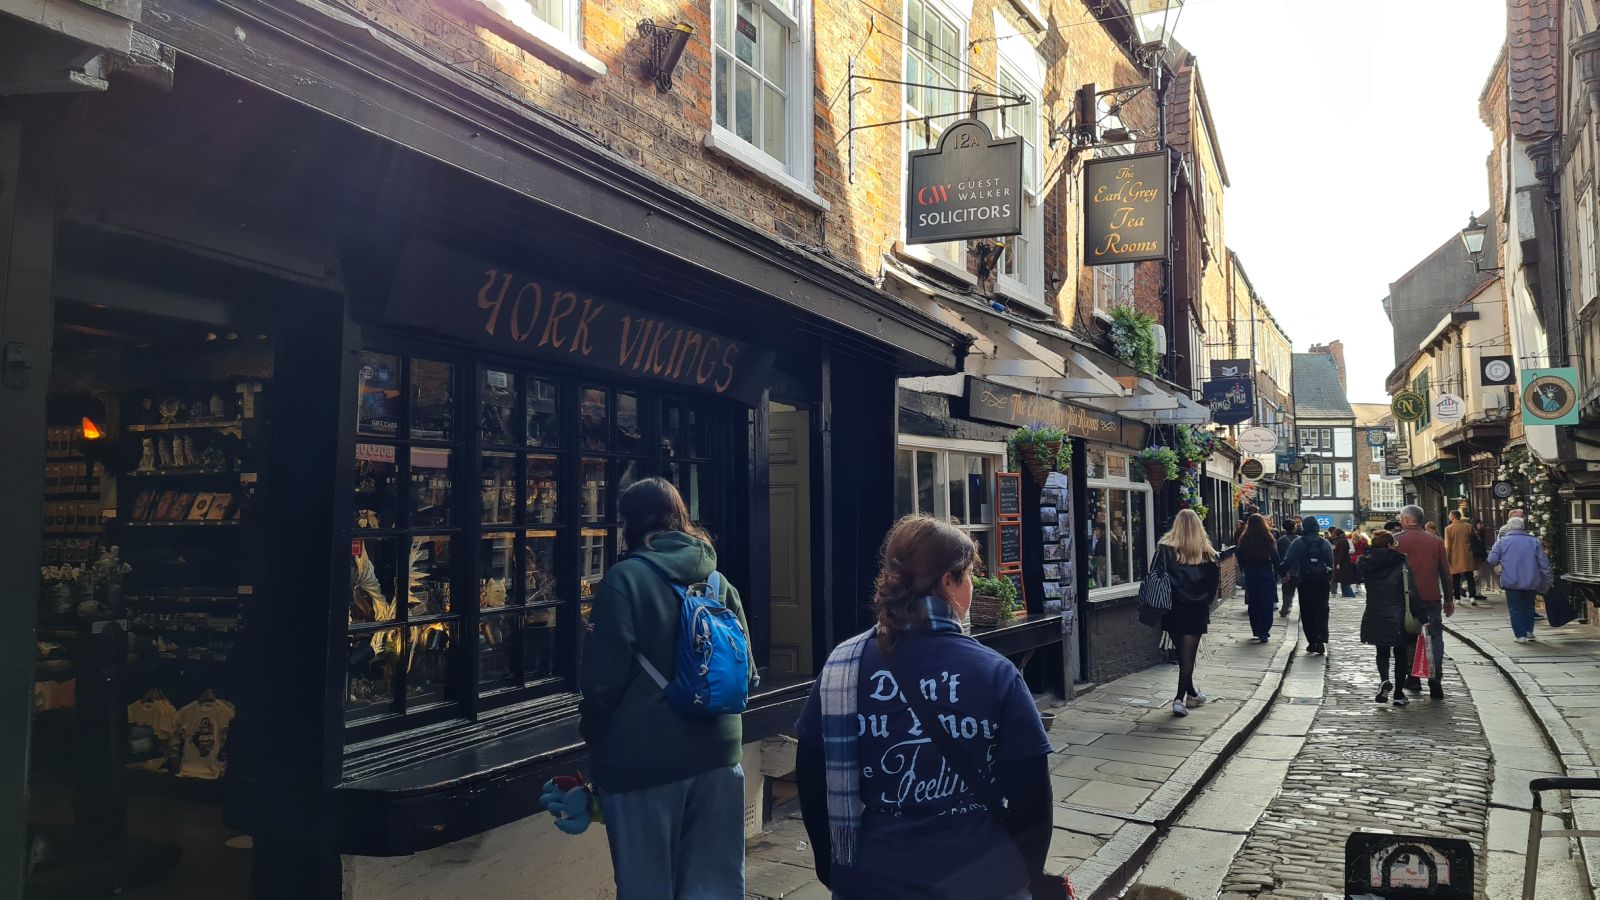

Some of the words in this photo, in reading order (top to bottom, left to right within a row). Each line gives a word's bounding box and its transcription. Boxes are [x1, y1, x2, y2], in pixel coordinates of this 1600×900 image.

[1116, 165, 1135, 180] The
[958, 178, 1001, 190] GUEST
[958, 188, 1011, 201] WALKER
[1094, 181, 1129, 203] Earl
[1123, 181, 1158, 203] Grey
[919, 204, 1011, 227] SOLICITORS
[1110, 207, 1145, 229] Tea
[1095, 233, 1158, 255] Rooms
[477, 269, 605, 356] YORK
[618, 316, 738, 393] VIKINGS
[870, 670, 960, 704] Dn't
[881, 738, 969, 808] Feelin
